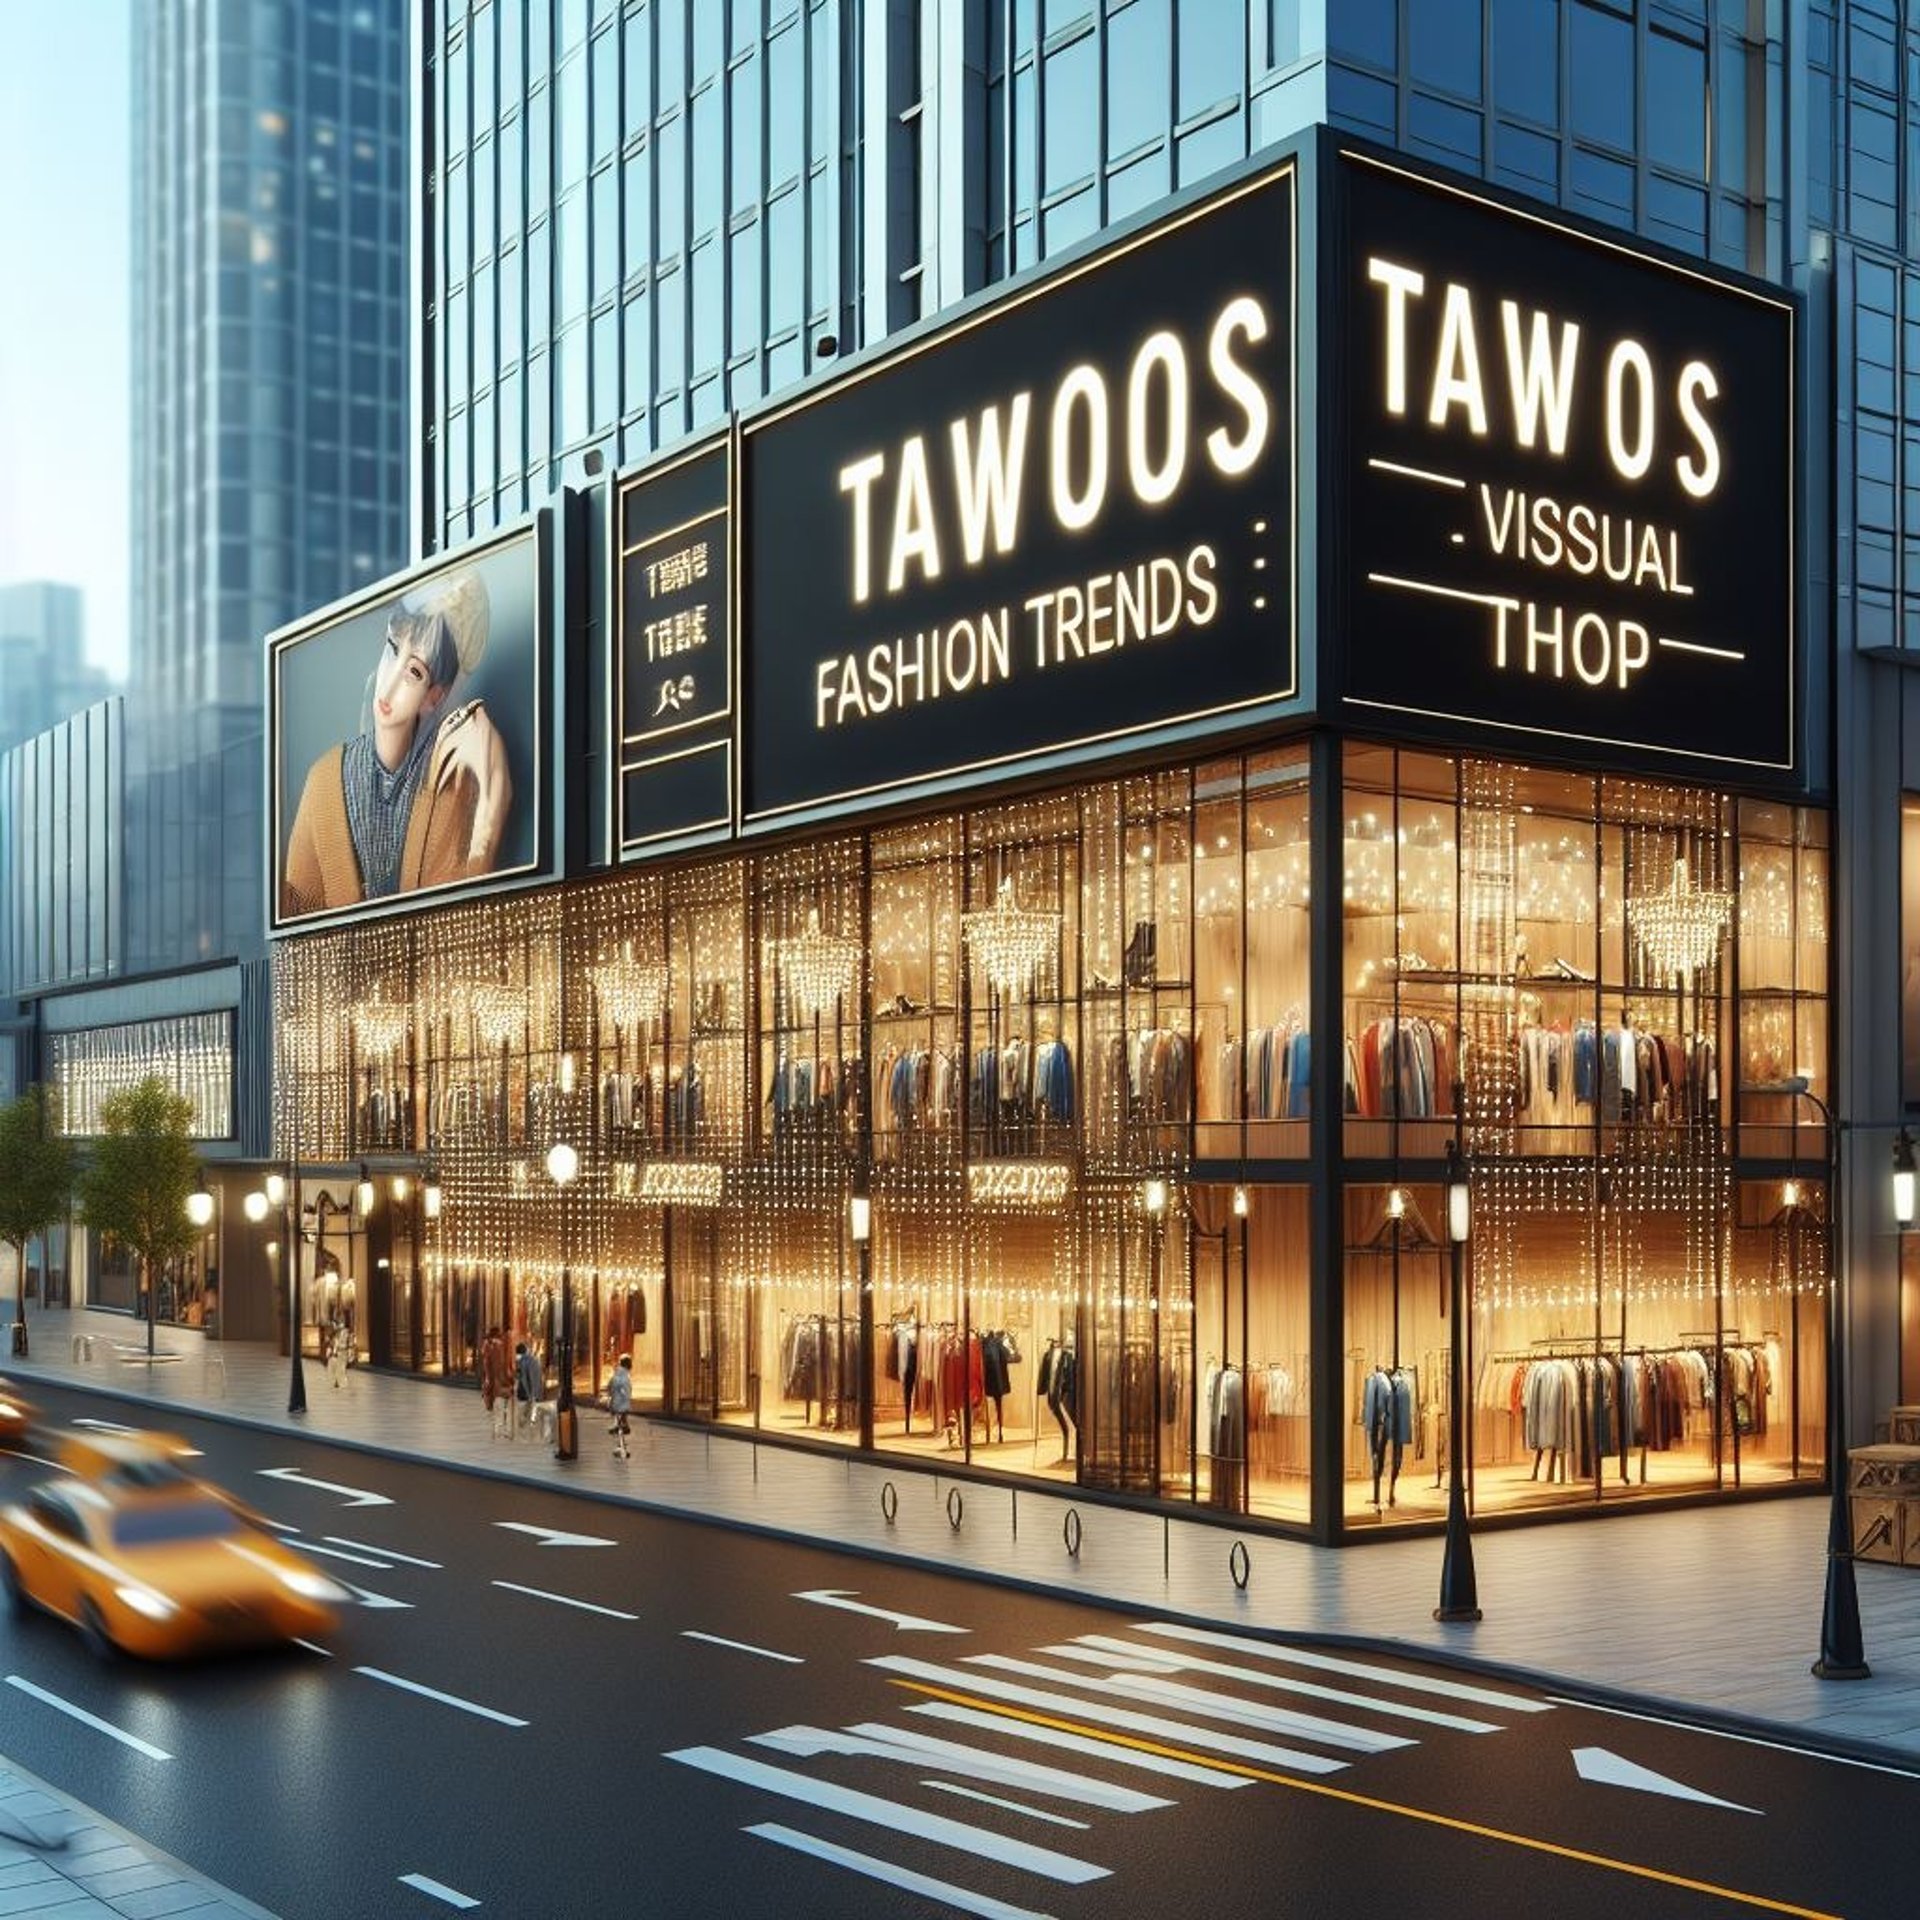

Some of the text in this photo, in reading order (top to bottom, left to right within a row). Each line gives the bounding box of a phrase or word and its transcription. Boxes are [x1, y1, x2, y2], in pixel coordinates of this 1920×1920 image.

[839, 297, 1270, 604] TAWOOS
[1368, 257, 1721, 498] TAWOS
[1480, 483, 1694, 595] VISSUAL
[816, 607, 1010, 728] FASHION
[1025, 544, 1218, 668] TRENDS
[1492, 597, 1650, 689] THOP
